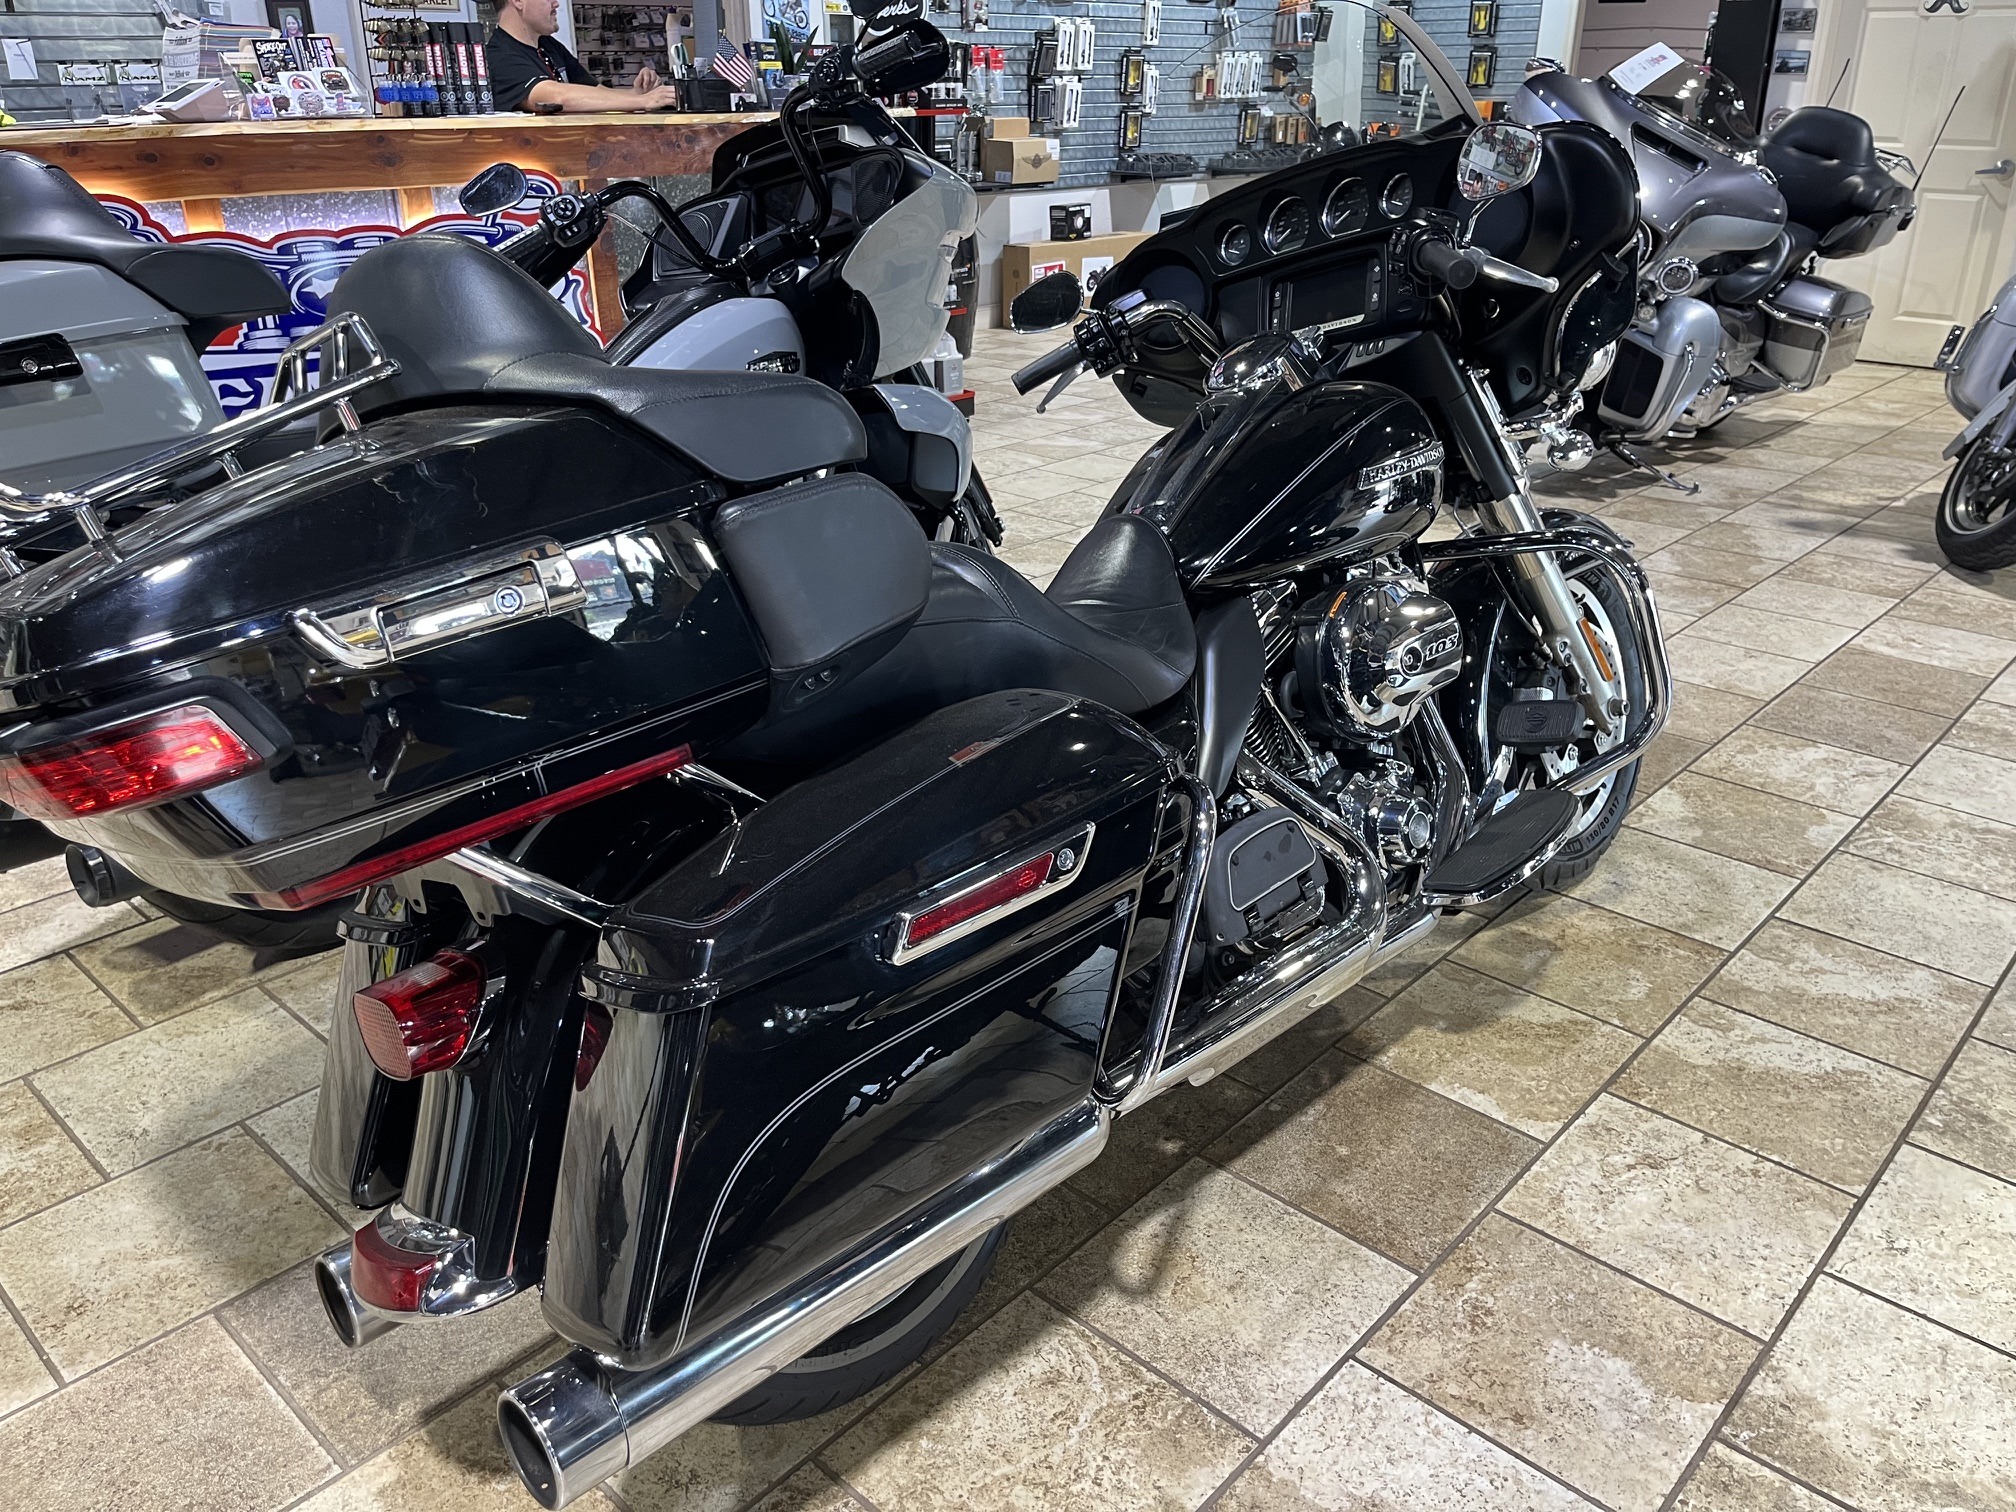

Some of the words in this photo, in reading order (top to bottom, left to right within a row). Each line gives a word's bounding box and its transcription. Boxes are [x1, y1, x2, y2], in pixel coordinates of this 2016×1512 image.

[1322, 317, 1358, 331] DAVIDSON
[1368, 446, 1444, 483] HARLEY-DAVIDSON
[1426, 632, 1459, 661] 103
[1586, 816, 1610, 843] 130/80
[1608, 796, 1620, 817] B17
